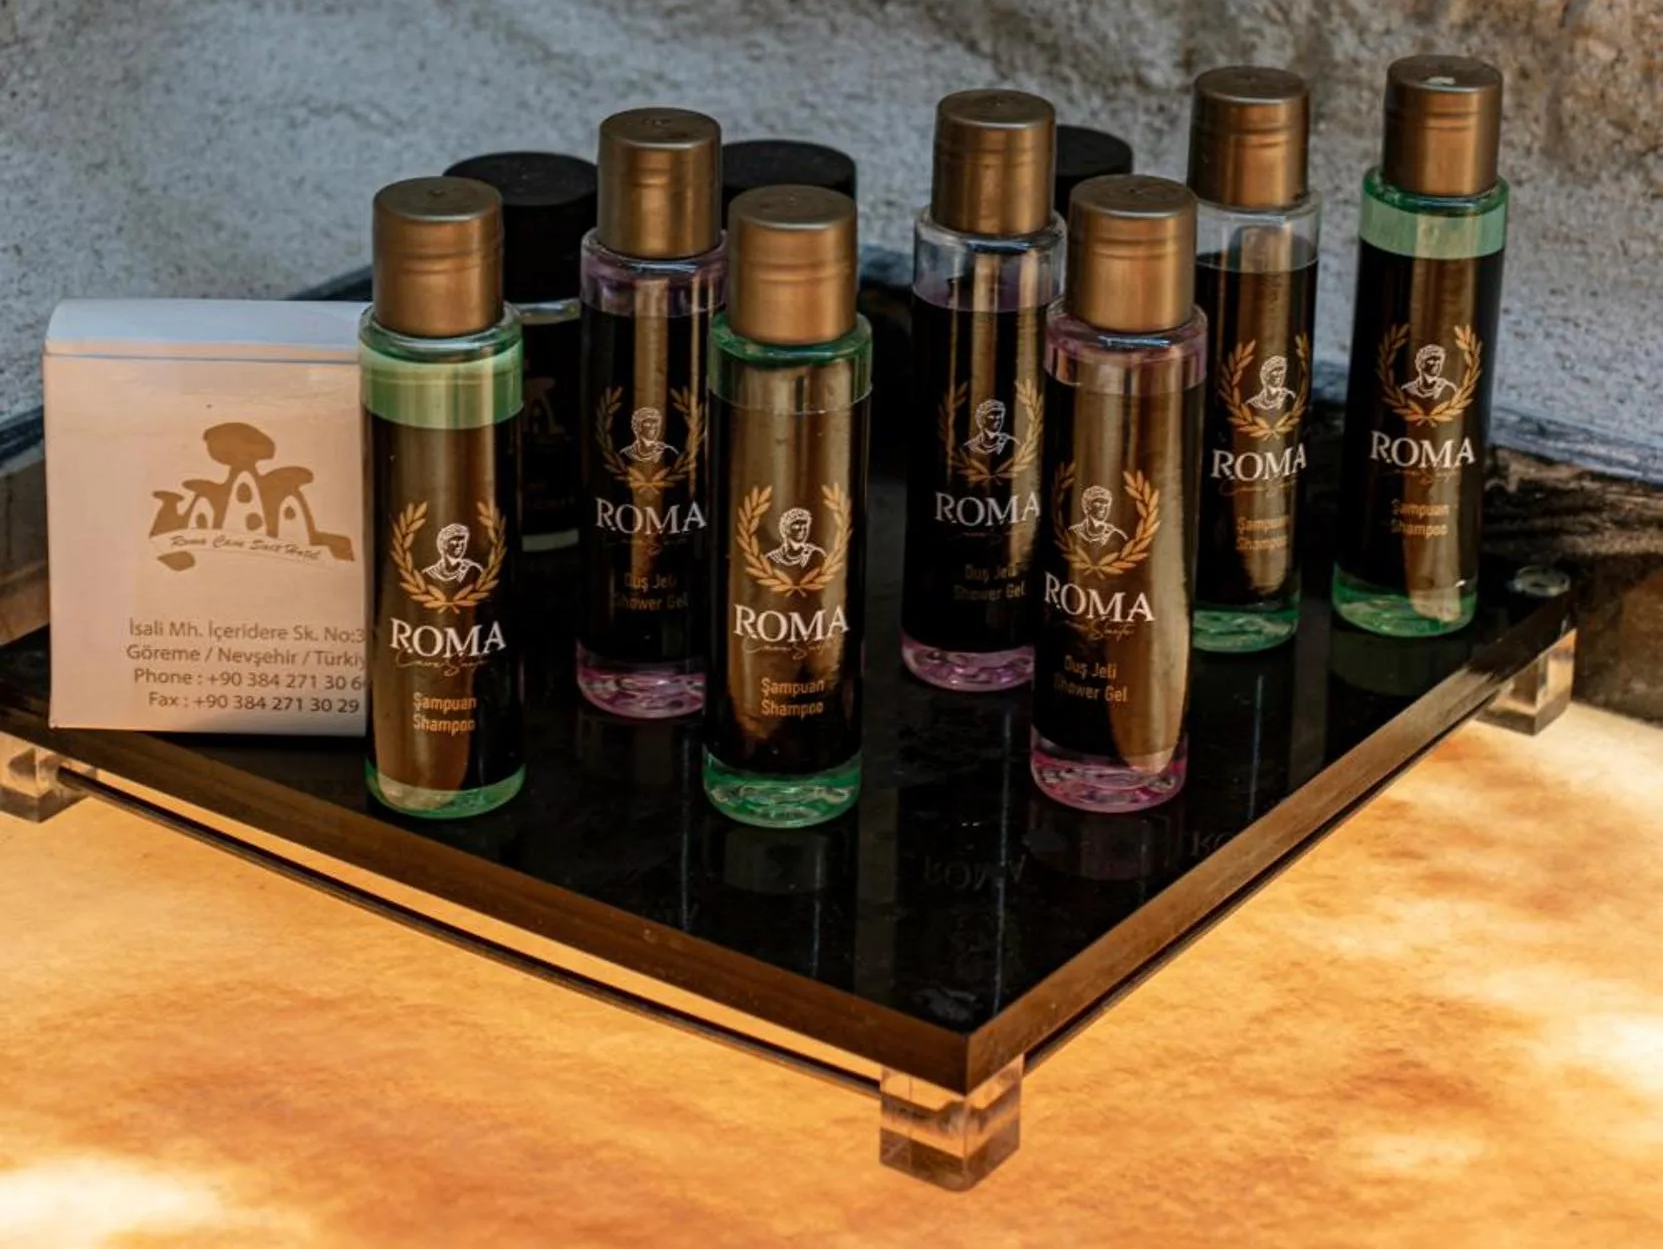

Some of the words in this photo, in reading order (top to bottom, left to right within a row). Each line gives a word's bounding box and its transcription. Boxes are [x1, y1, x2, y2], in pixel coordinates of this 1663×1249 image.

[1210, 442, 1307, 482] ROMA
[1369, 430, 1476, 469] ROMA
[595, 496, 707, 535] ROMA
[935, 491, 1041, 527] ROMA
[1044, 570, 1157, 623] ROMA
[169, 621, 203, 638] Mh.
[293, 624, 319, 642] Sk.
[390, 616, 507, 659] ROMA
[733, 603, 850, 643] ROMA
[126, 643, 201, 662] Göreme
[219, 648, 298, 667] Nevşehir
[134, 667, 193, 686] Phone
[208, 670, 243, 688] +90
[247, 671, 280, 688] 384
[286, 673, 318, 690] 271
[324, 674, 347, 691] 30
[1104, 684, 1129, 703] Gel
[148, 691, 179, 708] Fax
[193, 693, 229, 710] +90
[233, 694, 266, 711] 384
[272, 696, 304, 712] 271
[310, 697, 333, 713] 30
[337, 699, 360, 714] 29
[761, 699, 824, 722] Shampoo
[413, 713, 476, 737] Shampoo
